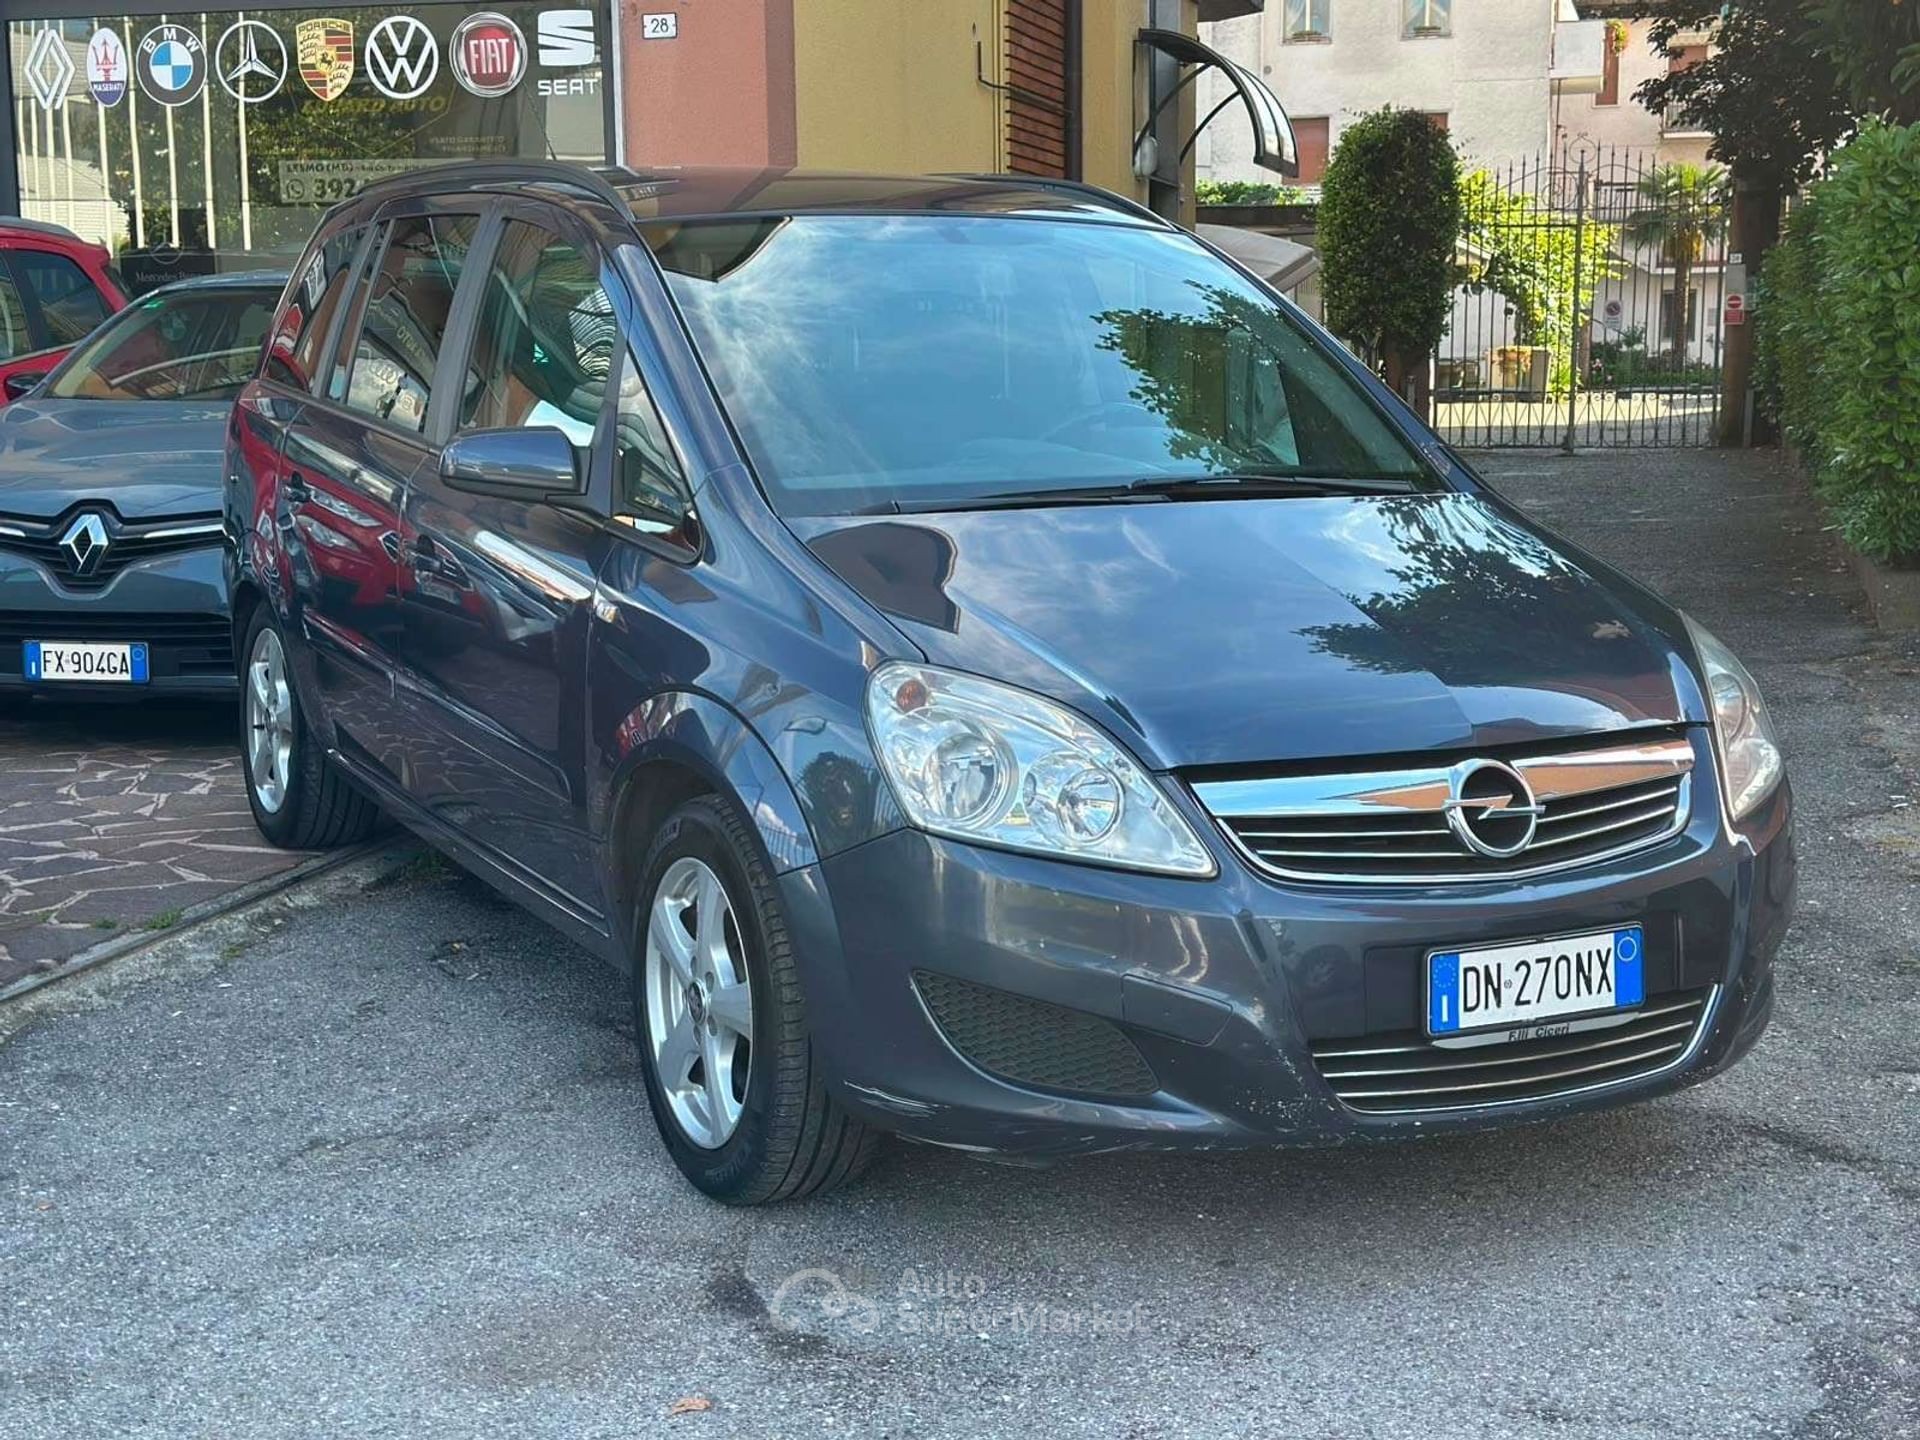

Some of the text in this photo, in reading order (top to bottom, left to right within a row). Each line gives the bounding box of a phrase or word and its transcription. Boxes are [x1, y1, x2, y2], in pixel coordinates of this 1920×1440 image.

[650, 17, 669, 33] 28
[142, 27, 200, 54] BMW
[469, 38, 510, 75] FIAT
[538, 79, 598, 96] SEAT
